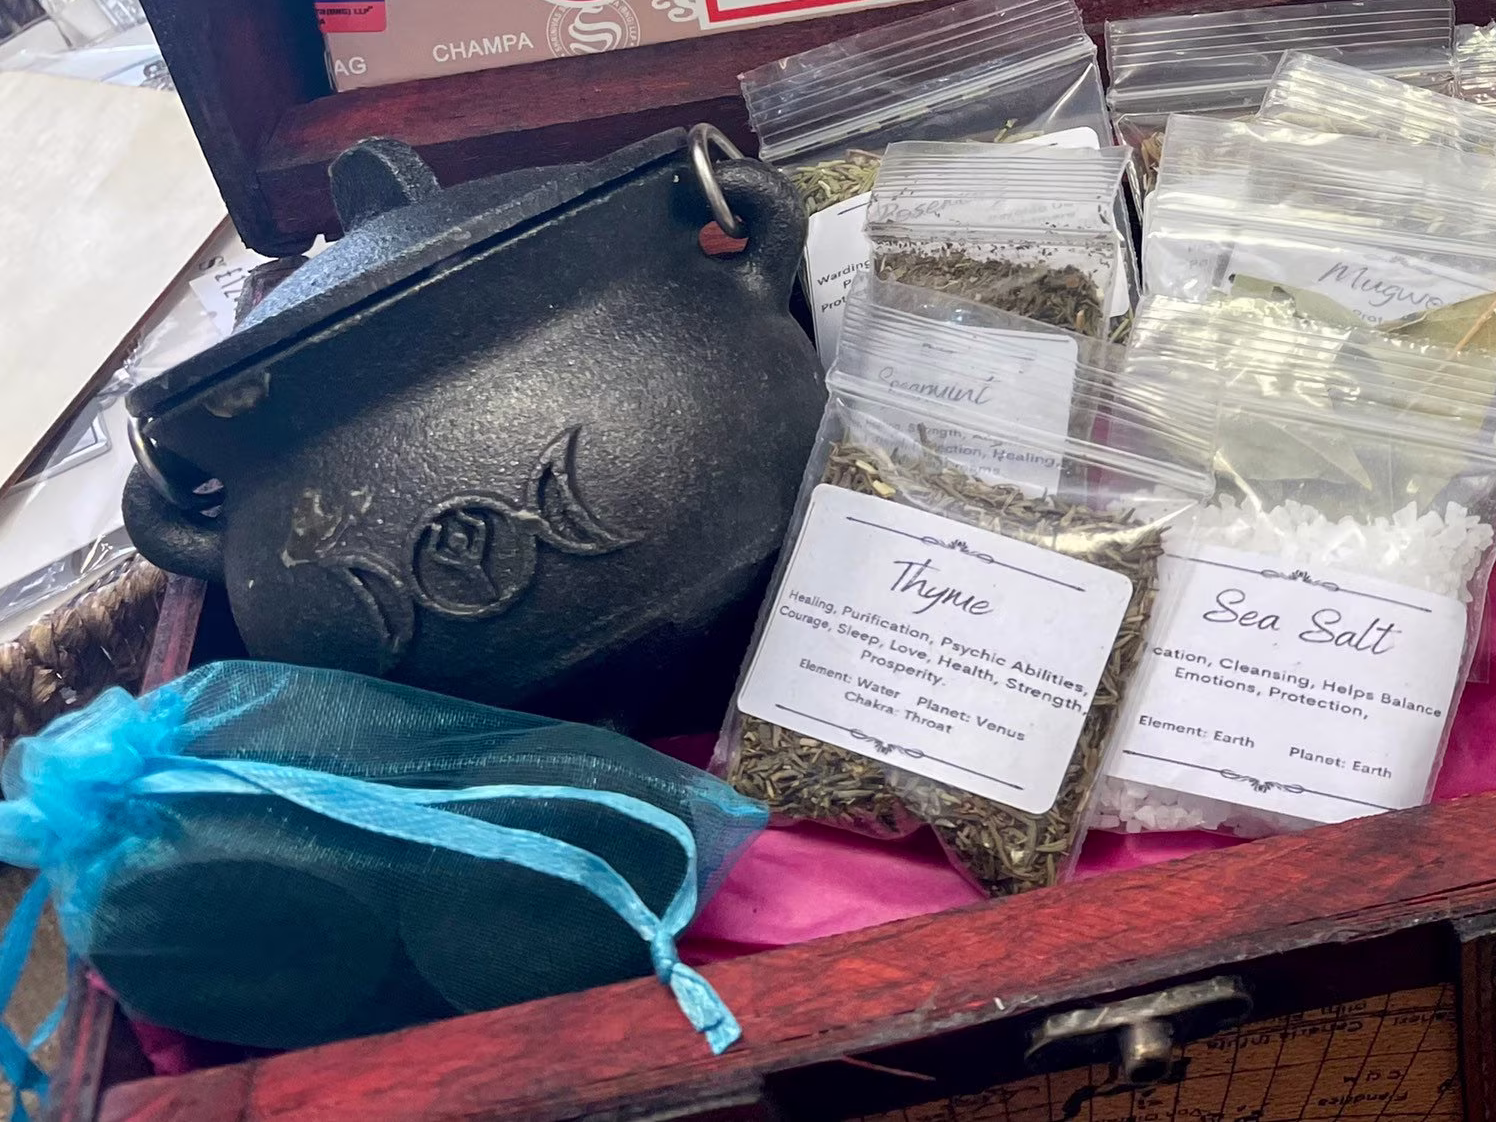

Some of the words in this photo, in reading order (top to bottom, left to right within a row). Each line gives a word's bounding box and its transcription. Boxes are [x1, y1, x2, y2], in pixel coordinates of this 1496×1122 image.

[433, 32, 534, 64] CHAMPA
[888, 558, 994, 615] Thyme
[1202, 588, 1281, 632] Sea
[1299, 608, 1403, 656] Salt
[940, 636, 1007, 666] Psychic
[857, 676, 902, 699] Water
[976, 715, 1025, 741] Venus
[1321, 679, 1374, 701] Helps
[1380, 692, 1441, 718] Balance
[904, 709, 954, 734] Throat
[1213, 730, 1255, 748] Earth
[1352, 760, 1392, 779] Earth
